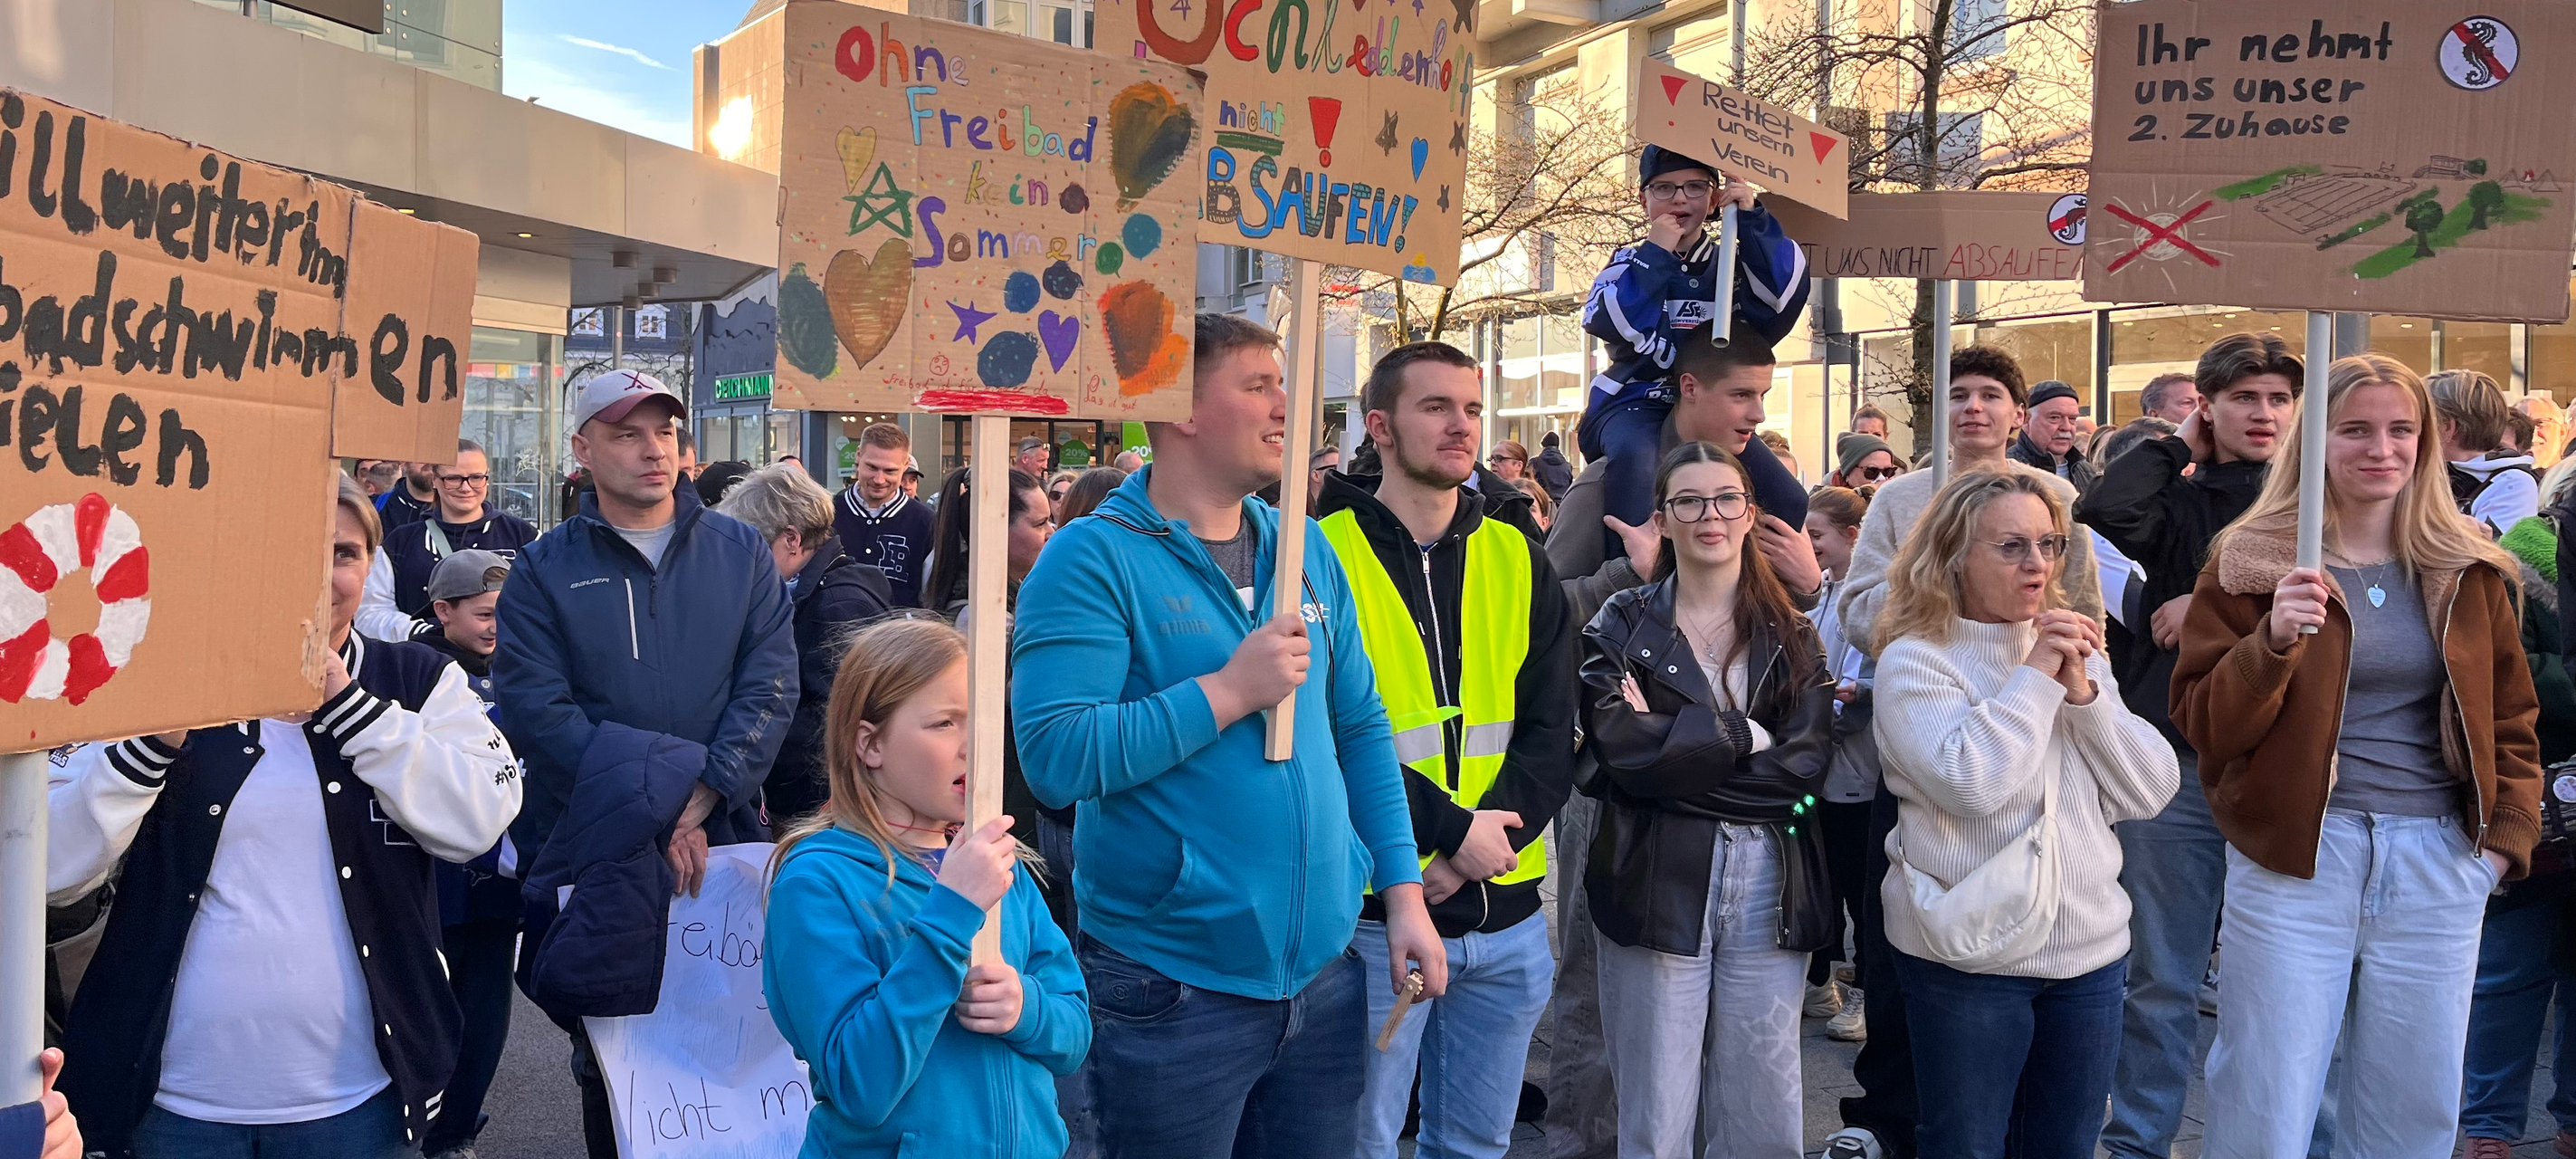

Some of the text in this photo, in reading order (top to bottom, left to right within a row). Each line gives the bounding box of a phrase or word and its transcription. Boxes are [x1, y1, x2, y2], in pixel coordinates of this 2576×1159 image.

[2136, 19, 2393, 66] Ihr nehmt
[1703, 81, 1794, 139] Rettet
[2134, 76, 2365, 105] uns unser
[906, 86, 1097, 163] Freibad
[1219, 100, 1284, 136] nicht
[1717, 117, 1794, 158] unsern
[2127, 110, 2350, 141] 2. Zuhause
[965, 161, 1048, 206] kein
[1711, 138, 1789, 184] Verein
[1198, 146, 1419, 254] BSAUFEN!
[101, 153, 305, 267] weiter
[298, 200, 348, 299] im
[913, 196, 1096, 267] Sommer
[1825, 246, 1874, 275] UNS
[1878, 245, 1939, 277] NICHT
[1125, 445, 1153, 457] -20
[667, 902, 764, 967] eibä
